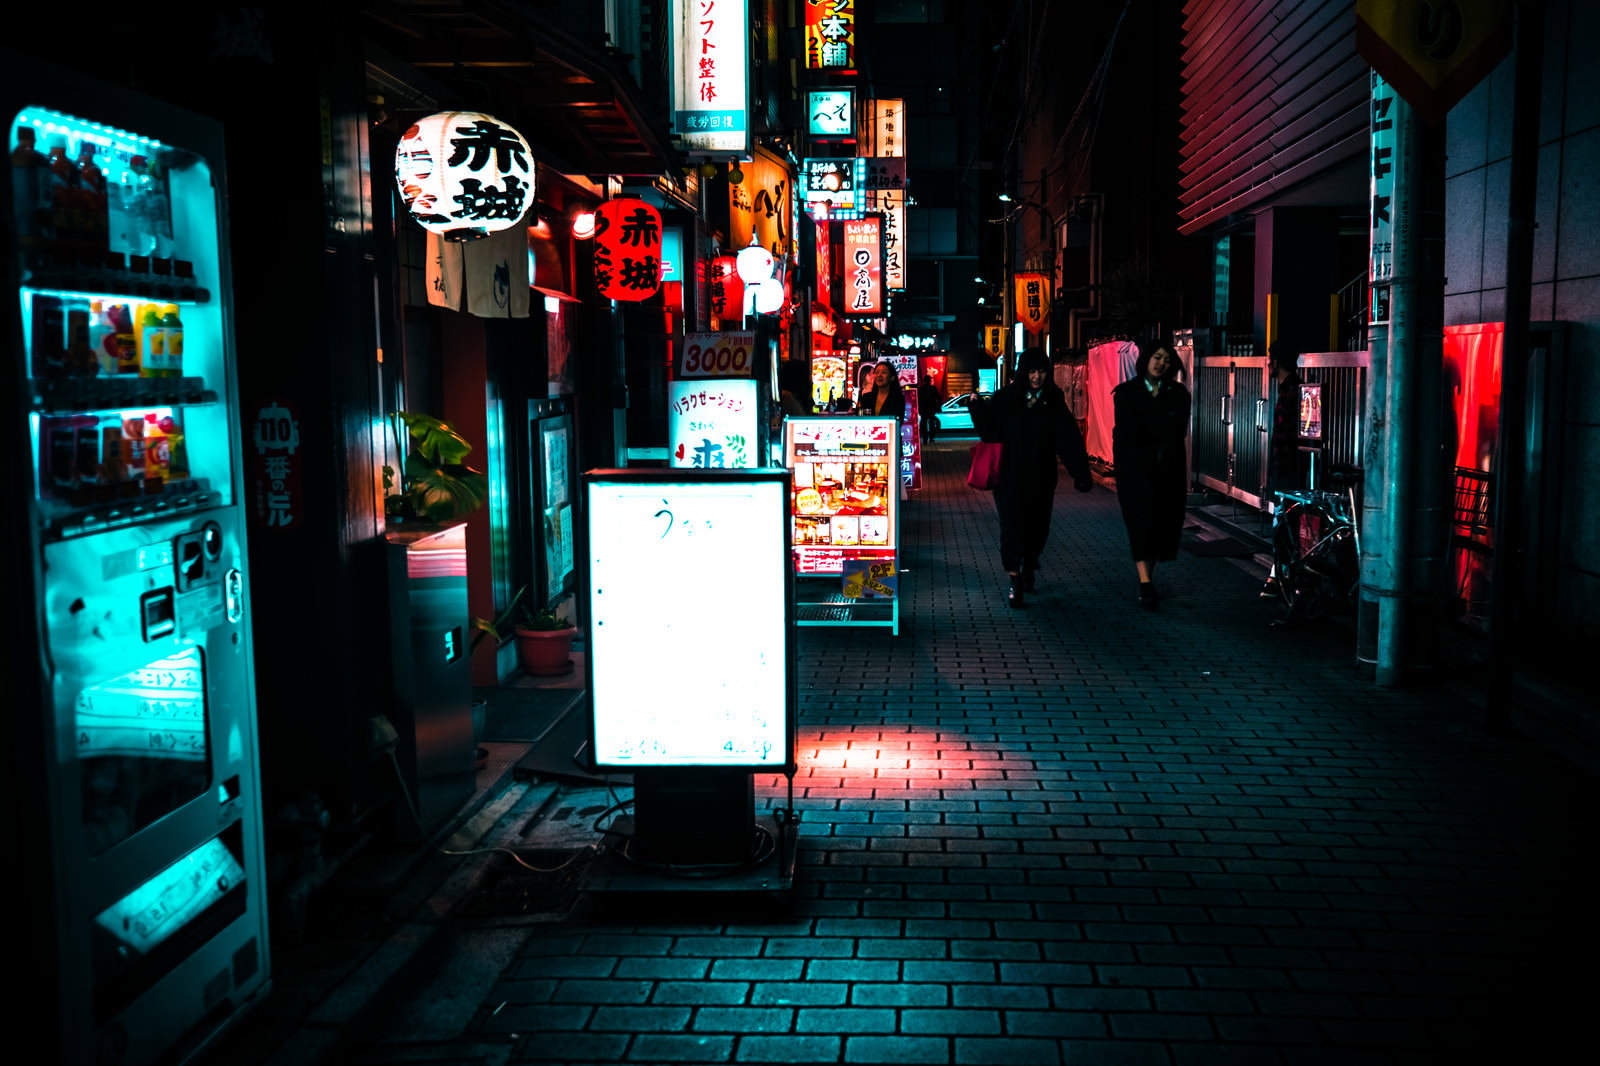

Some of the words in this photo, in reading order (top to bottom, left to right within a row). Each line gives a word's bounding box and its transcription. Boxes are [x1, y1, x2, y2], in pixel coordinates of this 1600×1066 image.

[686, 115, 735, 129] 疲労回復
[448, 120, 531, 222] 赤城
[620, 207, 659, 291] 赤城
[853, 249, 873, 310] 日高屋
